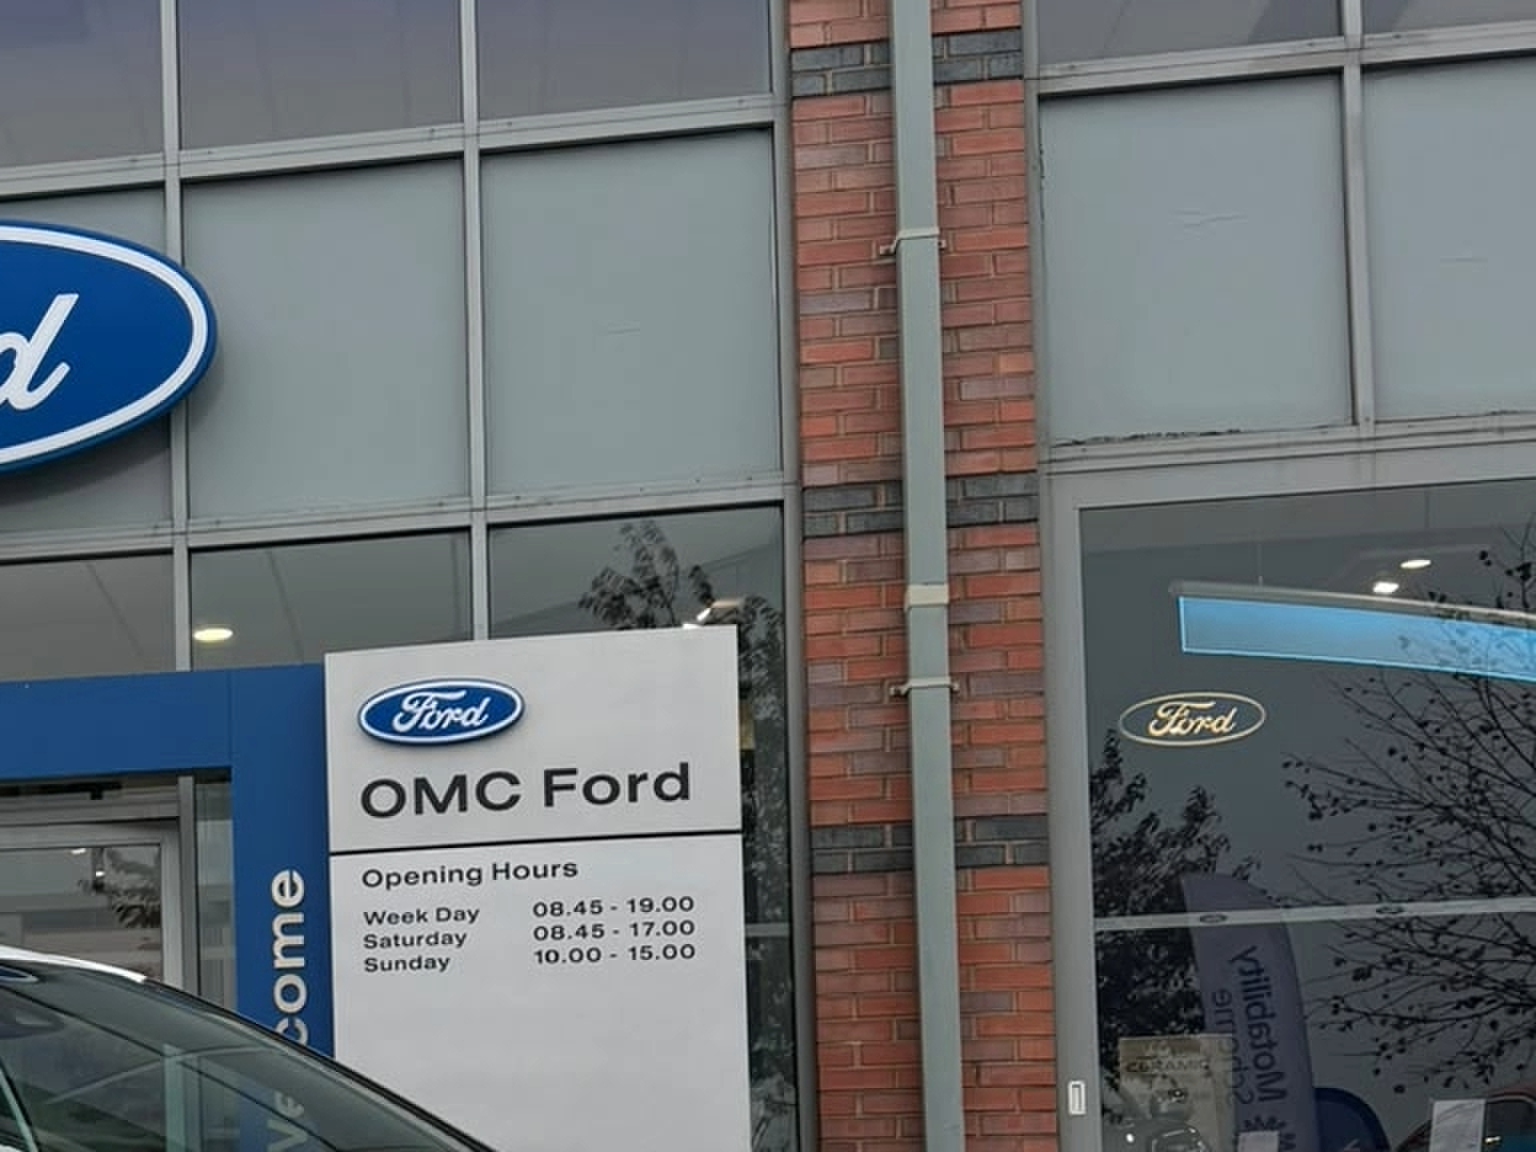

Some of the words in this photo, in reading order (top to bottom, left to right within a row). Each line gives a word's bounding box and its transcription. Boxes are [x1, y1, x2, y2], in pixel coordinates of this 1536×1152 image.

[391, 689, 491, 733] Ford
[1147, 701, 1238, 736] Ford
[361, 771, 522, 819] OMC
[543, 762, 690, 808] Ford
[362, 864, 483, 890] Opening
[492, 860, 579, 882] Hours
[363, 907, 428, 926] Week
[436, 905, 480, 924] Day
[533, 900, 603, 918] 08.45
[627, 896, 695, 914] 19.00
[363, 930, 467, 950] Saturday
[533, 923, 605, 941] 08.45
[629, 919, 696, 938] 17.00
[364, 955, 451, 973] Sunday
[533, 946, 602, 965] 10.00
[628, 944, 697, 962] 15.00
